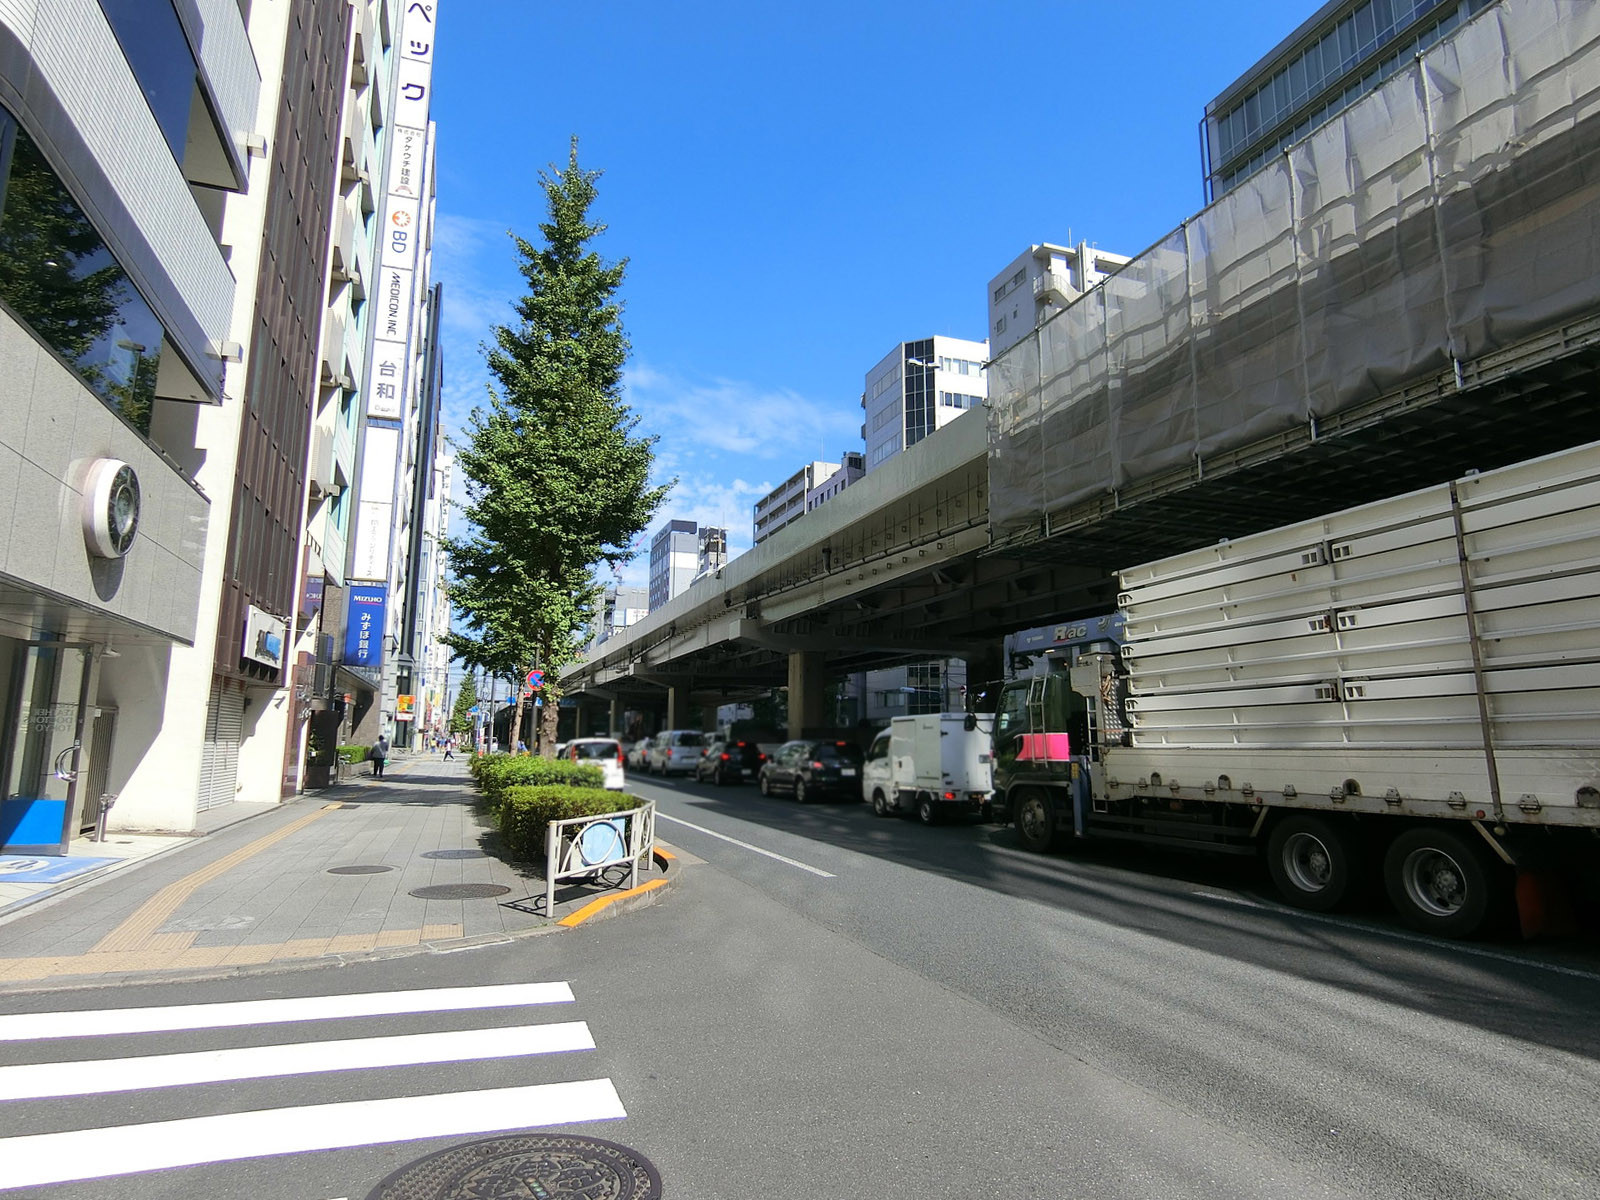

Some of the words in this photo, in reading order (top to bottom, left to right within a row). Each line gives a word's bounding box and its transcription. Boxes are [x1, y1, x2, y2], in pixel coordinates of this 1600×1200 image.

[391, 230, 407, 254] BD
[376, 360, 397, 400] 台和
[353, 595, 383, 603] MIZUHO
[357, 612, 372, 659] みずほ銀行
